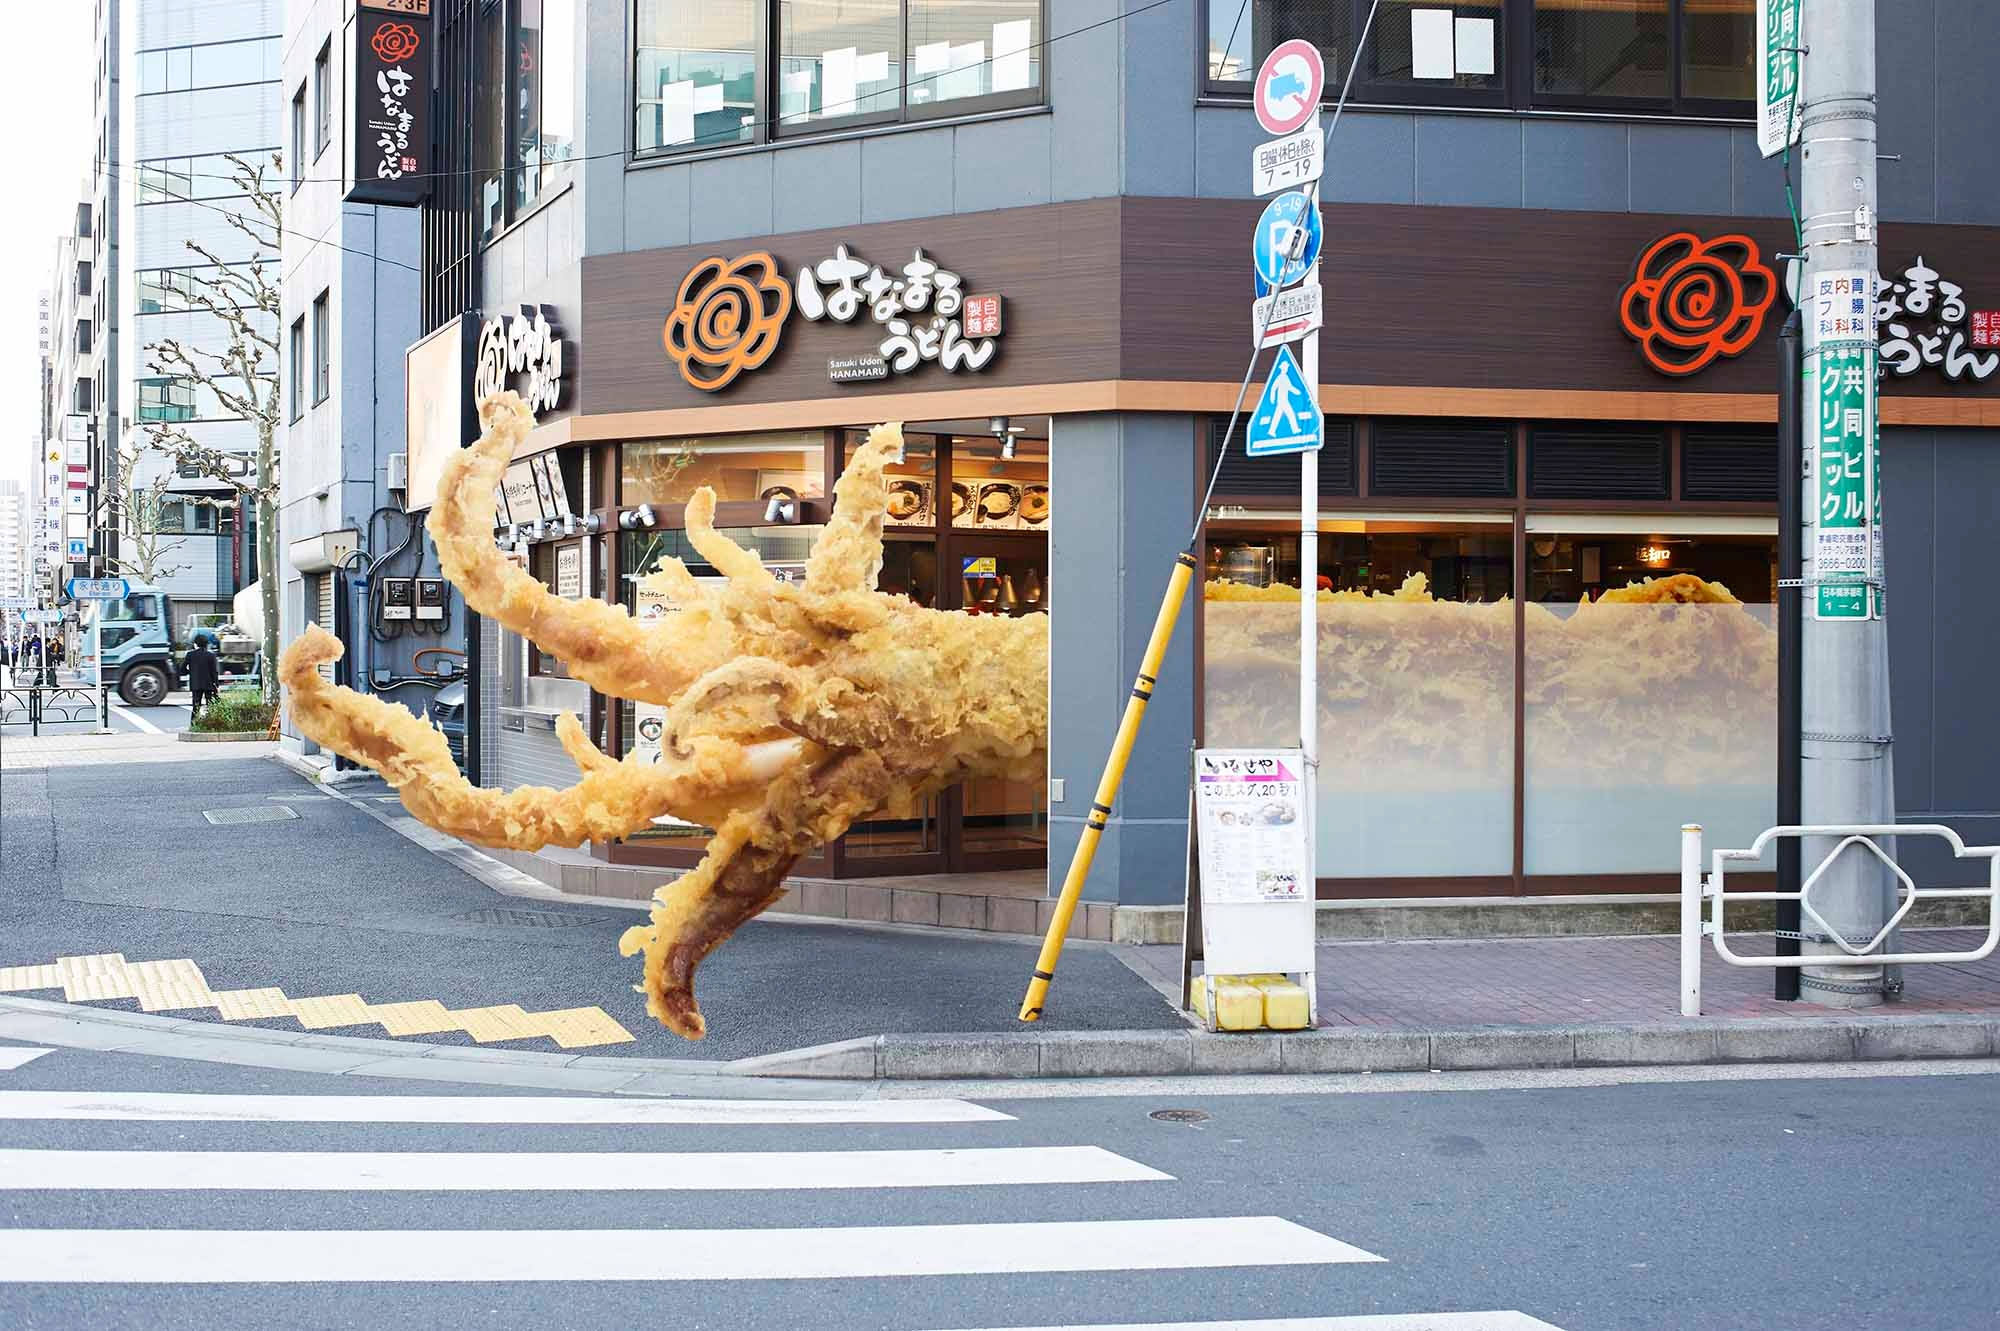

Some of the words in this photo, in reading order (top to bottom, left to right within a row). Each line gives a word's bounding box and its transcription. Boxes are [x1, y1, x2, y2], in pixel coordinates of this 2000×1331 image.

[797, 245, 962, 320] はなまる
[1820, 280, 1833, 335] 皮フ科
[1835, 278, 1849, 334] 内科
[1851, 278, 1864, 334] 胃腸科
[830, 360, 858, 369] Sanuki
[860, 358, 882, 366] Udon
[880, 318, 993, 371] うどん
[1878, 323, 1999, 378] うどん
[830, 367, 885, 379] HANAMARU
[1822, 366, 1841, 521] クリニック
[1843, 365, 1863, 521] 共同ビル
